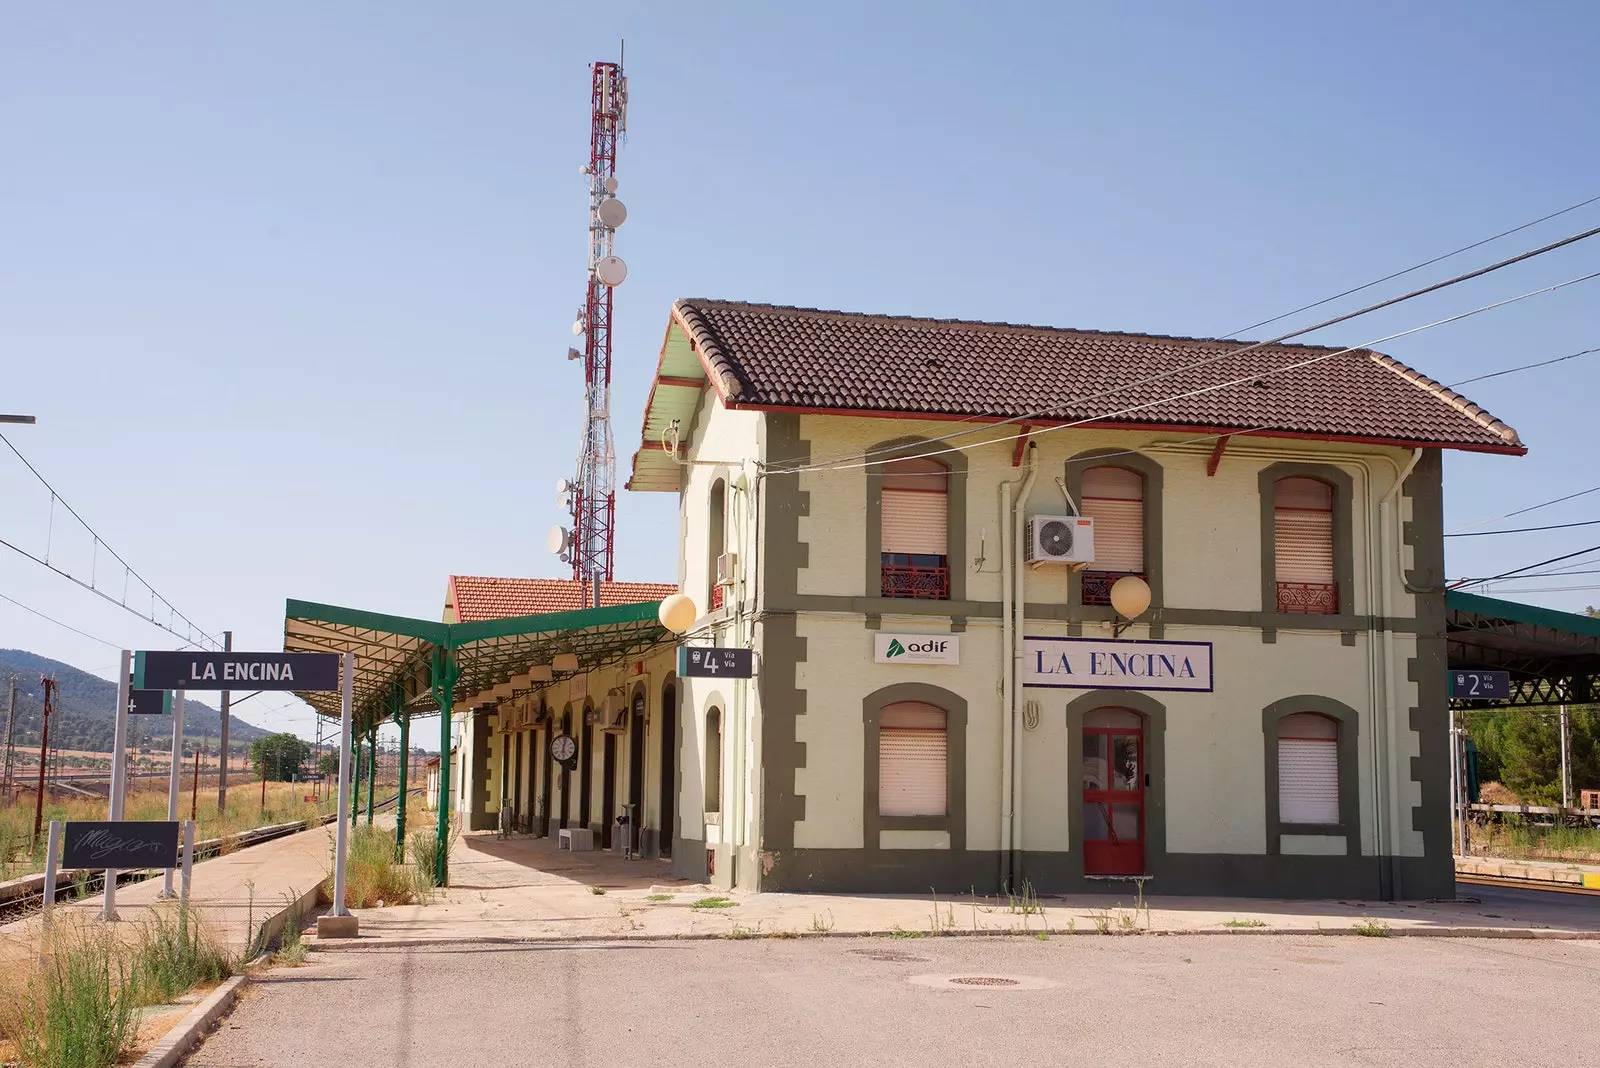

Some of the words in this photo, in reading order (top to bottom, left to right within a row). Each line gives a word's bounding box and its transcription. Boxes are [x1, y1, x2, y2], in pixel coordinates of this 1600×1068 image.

[908, 640, 948, 653] adif
[191, 662, 217, 680] LA
[223, 662, 294, 681] ENCINA
[703, 651, 719, 674] 4
[1034, 650, 1074, 675] LA
[1089, 651, 1196, 679] ENCINA
[1468, 674, 1480, 695] 2
